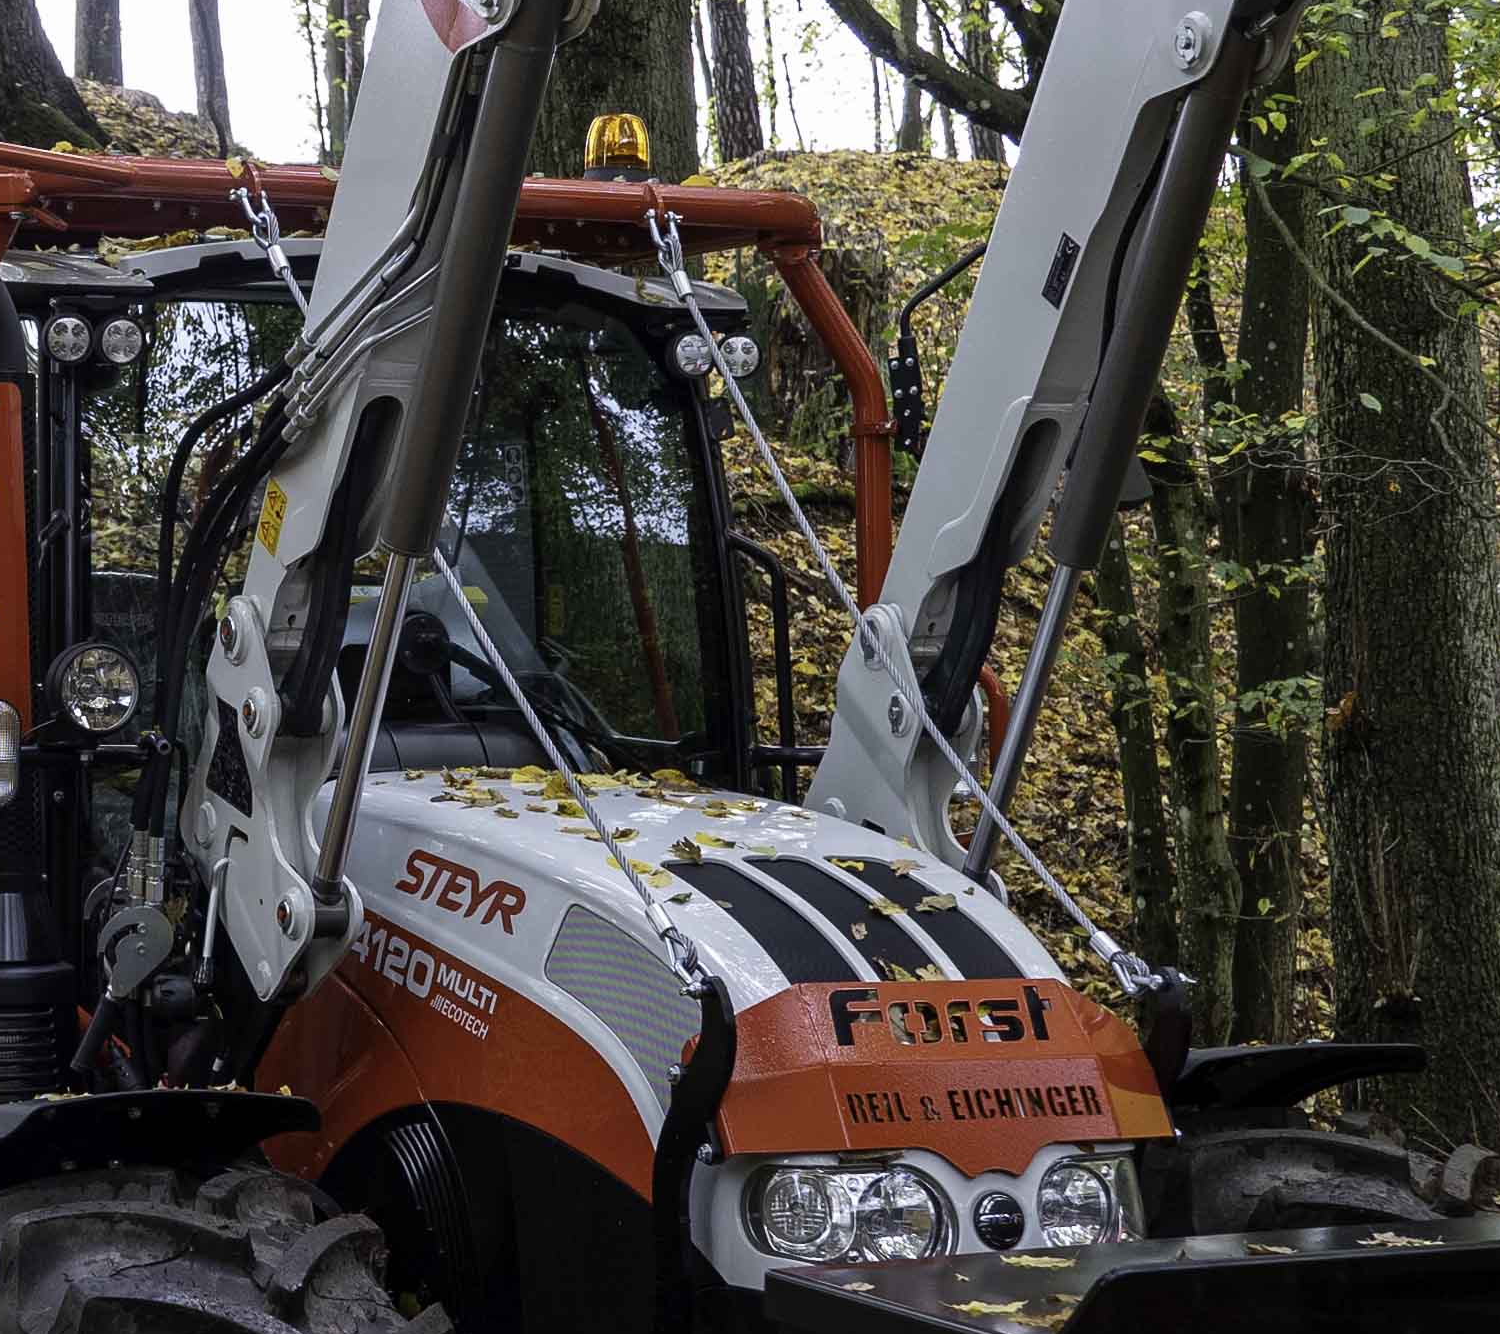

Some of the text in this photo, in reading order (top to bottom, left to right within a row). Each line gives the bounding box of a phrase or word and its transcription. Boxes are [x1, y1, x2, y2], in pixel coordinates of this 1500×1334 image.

[394, 849, 528, 935] STEYR
[351, 921, 436, 999] 4120
[436, 963, 499, 1015] MULTI
[828, 985, 1053, 1047] Forst
[440, 998, 490, 1040] ECOTECH
[846, 1085, 1102, 1124] REIL & EICHINGER
